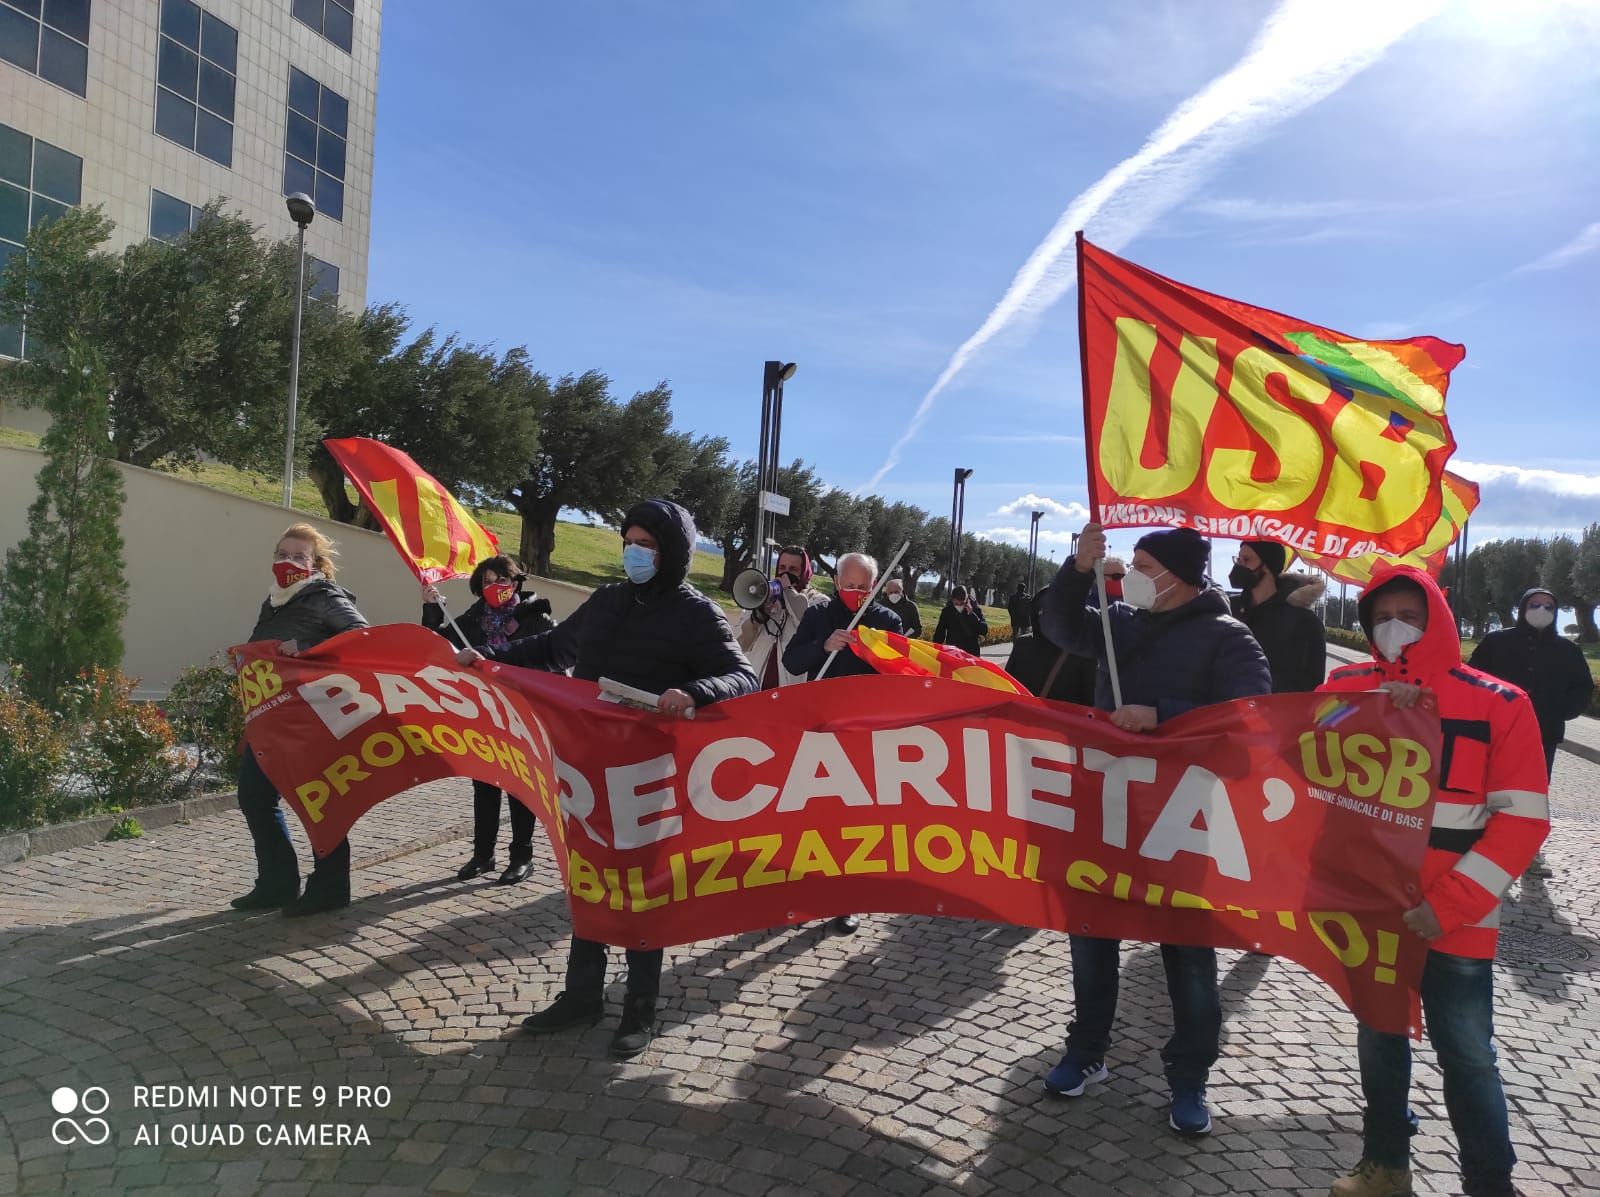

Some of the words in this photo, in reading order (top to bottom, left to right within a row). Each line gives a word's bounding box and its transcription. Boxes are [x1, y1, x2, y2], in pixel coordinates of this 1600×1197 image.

[1099, 316, 1447, 533] USB
[1099, 503, 1187, 526] UNIONE
[1321, 534, 1349, 556] DI
[296, 664, 542, 761] BASTA
[295, 724, 535, 823] PROROGHE
[531, 712, 1296, 882] RECARIETA'
[1299, 731, 1432, 809] USB
[1307, 787, 1337, 805] UNIONE
[1336, 794, 1380, 819] SINDACALE
[1381, 808, 1393, 822] DI
[1395, 812, 1425, 831] BASE
